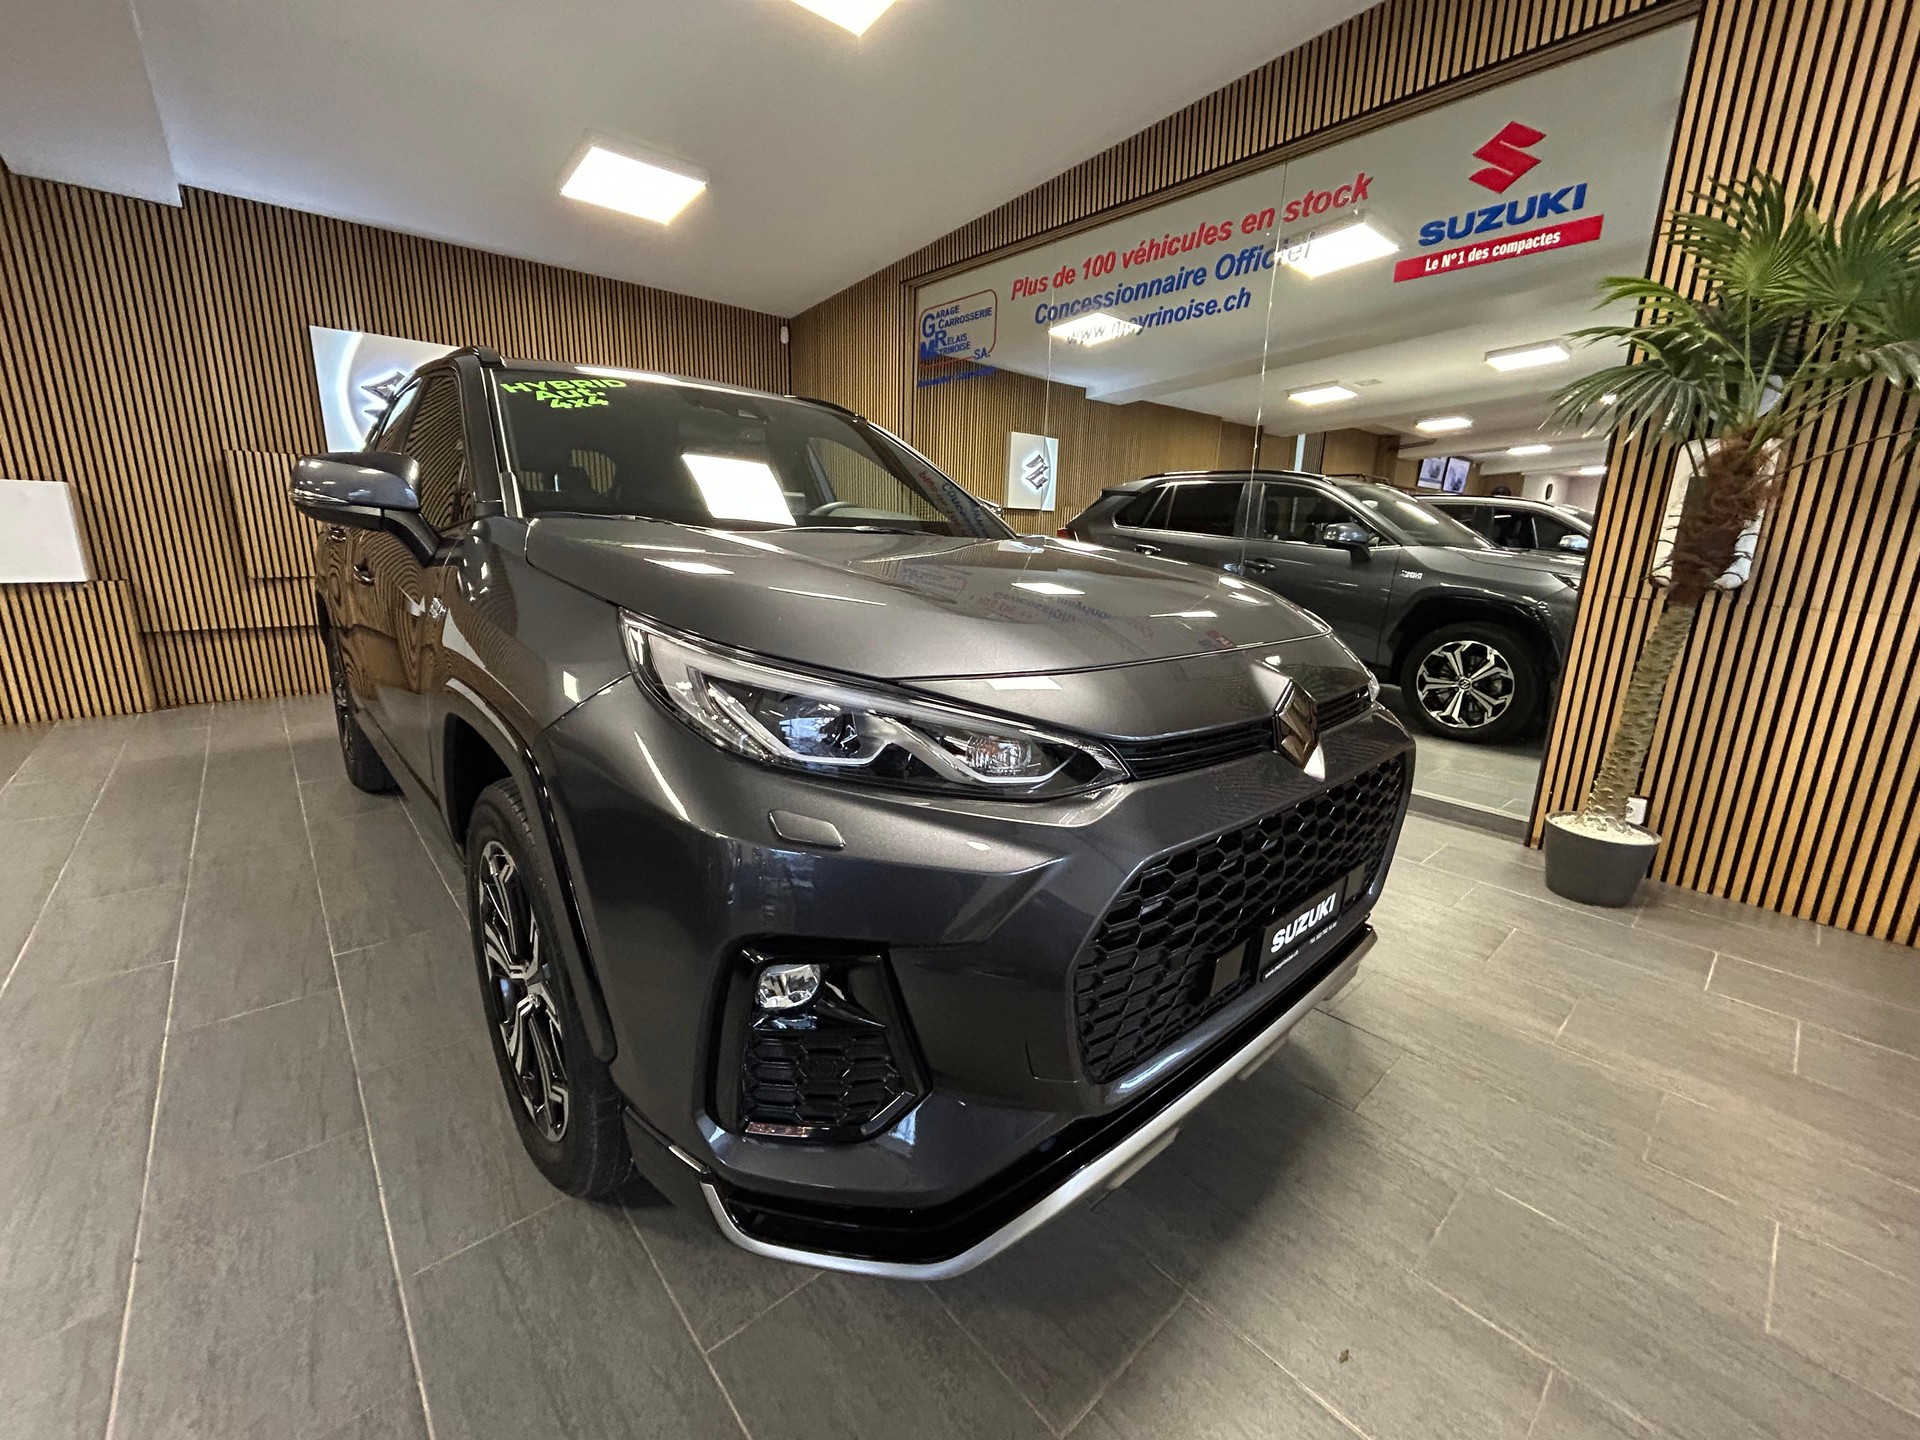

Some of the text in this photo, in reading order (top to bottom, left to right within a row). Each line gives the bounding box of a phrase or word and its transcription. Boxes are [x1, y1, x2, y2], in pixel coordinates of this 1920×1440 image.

[1418, 182, 1588, 247] SUZUKI
[1011, 172, 1374, 300] Plus de 100 véhicules en stock
[1424, 257, 1439, 272] Le
[1467, 247, 1489, 262] des
[1492, 231, 1561, 256] compactes
[1034, 266, 1207, 325] Concessionnaire
[1066, 287, 1252, 345] wwwmeyrinoise.ch
[922, 305, 960, 338] GARAGE
[938, 306, 993, 329] CARROSSERIE
[934, 330, 968, 348] RELAIS
[500, 379, 627, 393] HYBRID
[536, 388, 606, 401] Aut.
[1270, 892, 1337, 954] SUZUKI
